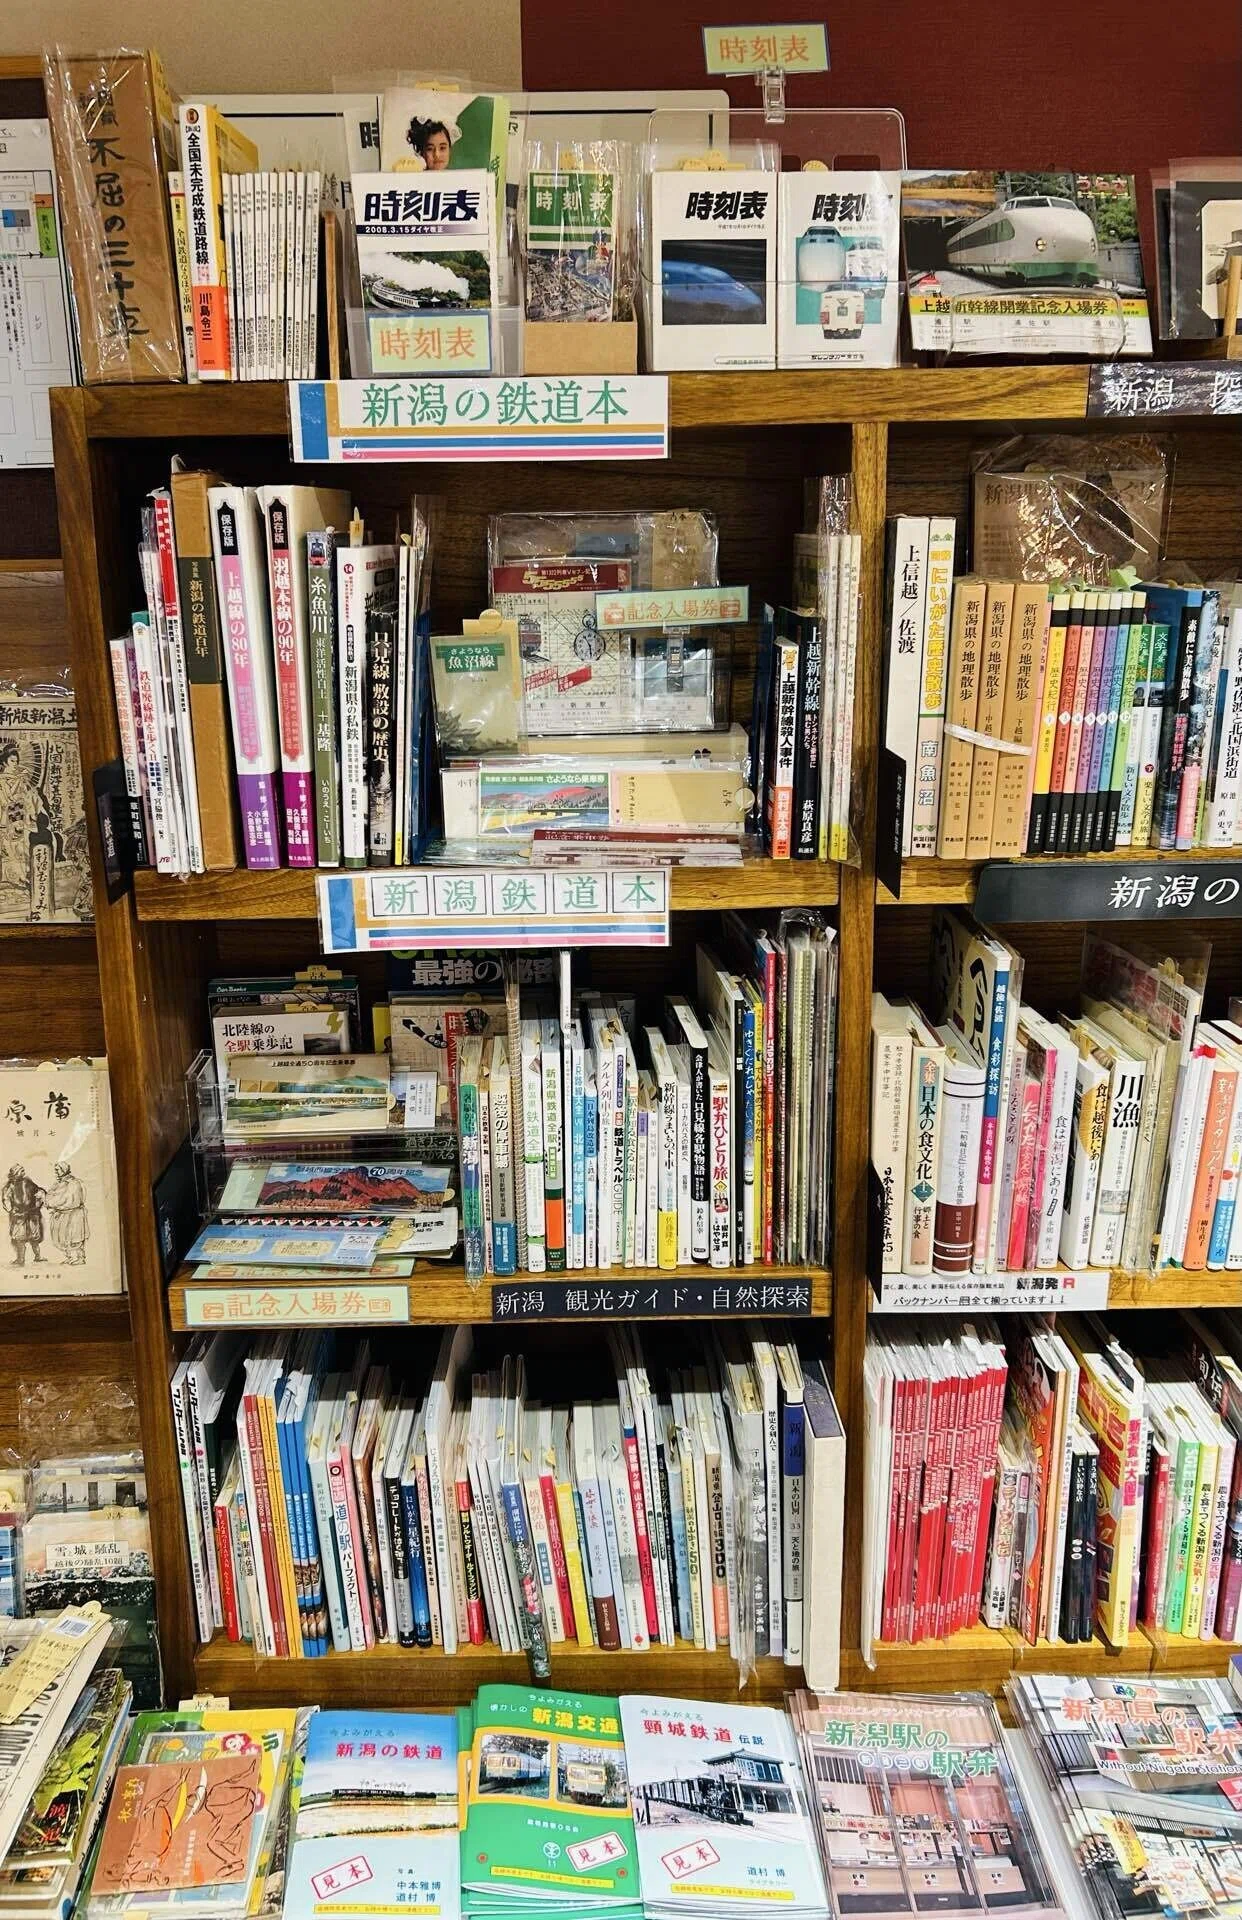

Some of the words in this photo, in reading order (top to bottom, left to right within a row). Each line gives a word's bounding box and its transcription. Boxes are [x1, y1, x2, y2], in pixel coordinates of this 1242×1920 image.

[719, 34, 810, 64] 時刻表
[186, 133, 209, 266] 全国未完成鉄道路線
[364, 189, 480, 222] 時刻表
[535, 191, 608, 212] 時刻表
[685, 190, 768, 221] 時刻表
[199, 293, 212, 341] 川島令三
[919, 299, 1109, 316] 上越新幹線開業記念入場券
[380, 327, 475, 359] 時刻表
[362, 380, 628, 427] 新潟の鉄道本
[1110, 377, 1174, 411] 新潟
[221, 514, 235, 546] 保存版
[272, 511, 285, 544] 保存版
[227, 571, 249, 668] 上越線の80年
[273, 557, 295, 666] 羽越本線の90年
[311, 576, 327, 634] 糸魚川
[626, 600, 720, 622] 記念入場券
[924, 567, 949, 710] にいがた歴史散歩
[960, 600, 980, 701] 新潟県の地理散歩
[985, 600, 1006, 700] 新潟県の地理散歩
[1016, 603, 1038, 701] 新潟県の地理散歩
[447, 655, 496, 669] 魚沼線
[804, 627, 822, 711] 上越新幹線
[344, 665, 359, 741] 新潟県の私鉄
[372, 631, 392, 762] 只見線敷設の歴史
[779, 673, 796, 768] 上越新幹線殺人事件
[918, 740, 938, 807] 南魚沼
[383, 875, 656, 914] 新潟鉄道本
[1108, 874, 1240, 909] 新潟の
[222, 1023, 275, 1037] 北陸線の
[224, 1036, 293, 1053] 全駅乗歩記
[1112, 1074, 1144, 1128] 川漁
[713, 1097, 728, 1180] 駅弁ひとり旅
[916, 1085, 937, 1180] 日本の食文化
[462, 1136, 479, 1165] 新潟
[495, 1290, 545, 1314] 新潟
[564, 1285, 810, 1312] 観光ガイド・自然探索
[1016, 1277, 1058, 1290] 新潟発
[225, 1291, 368, 1319] 記念入場券
[335, 1504, 351, 1550] 道の駅
[532, 1707, 619, 1734] 新潟交通
[1061, 1698, 1186, 1726] 新潟県の
[261, 1733, 280, 1752] JR
[643, 1719, 732, 1743] 頸城鉄道
[739, 1734, 765, 1746] 伝説
[825, 1720, 949, 1748] 新潟駅の
[1173, 1728, 1242, 1755] 駅弁
[336, 1742, 443, 1760] 新潟の鉄道
[931, 1750, 999, 1778] 駅弁
[1097, 1759, 1146, 1772] Without
[1149, 1762, 1199, 1776] Niigata
[579, 1840, 618, 1864] 見本
[672, 1843, 714, 1871] 見本
[322, 1863, 364, 1891] 見本
[396, 1881, 441, 1891] 中本雅博
